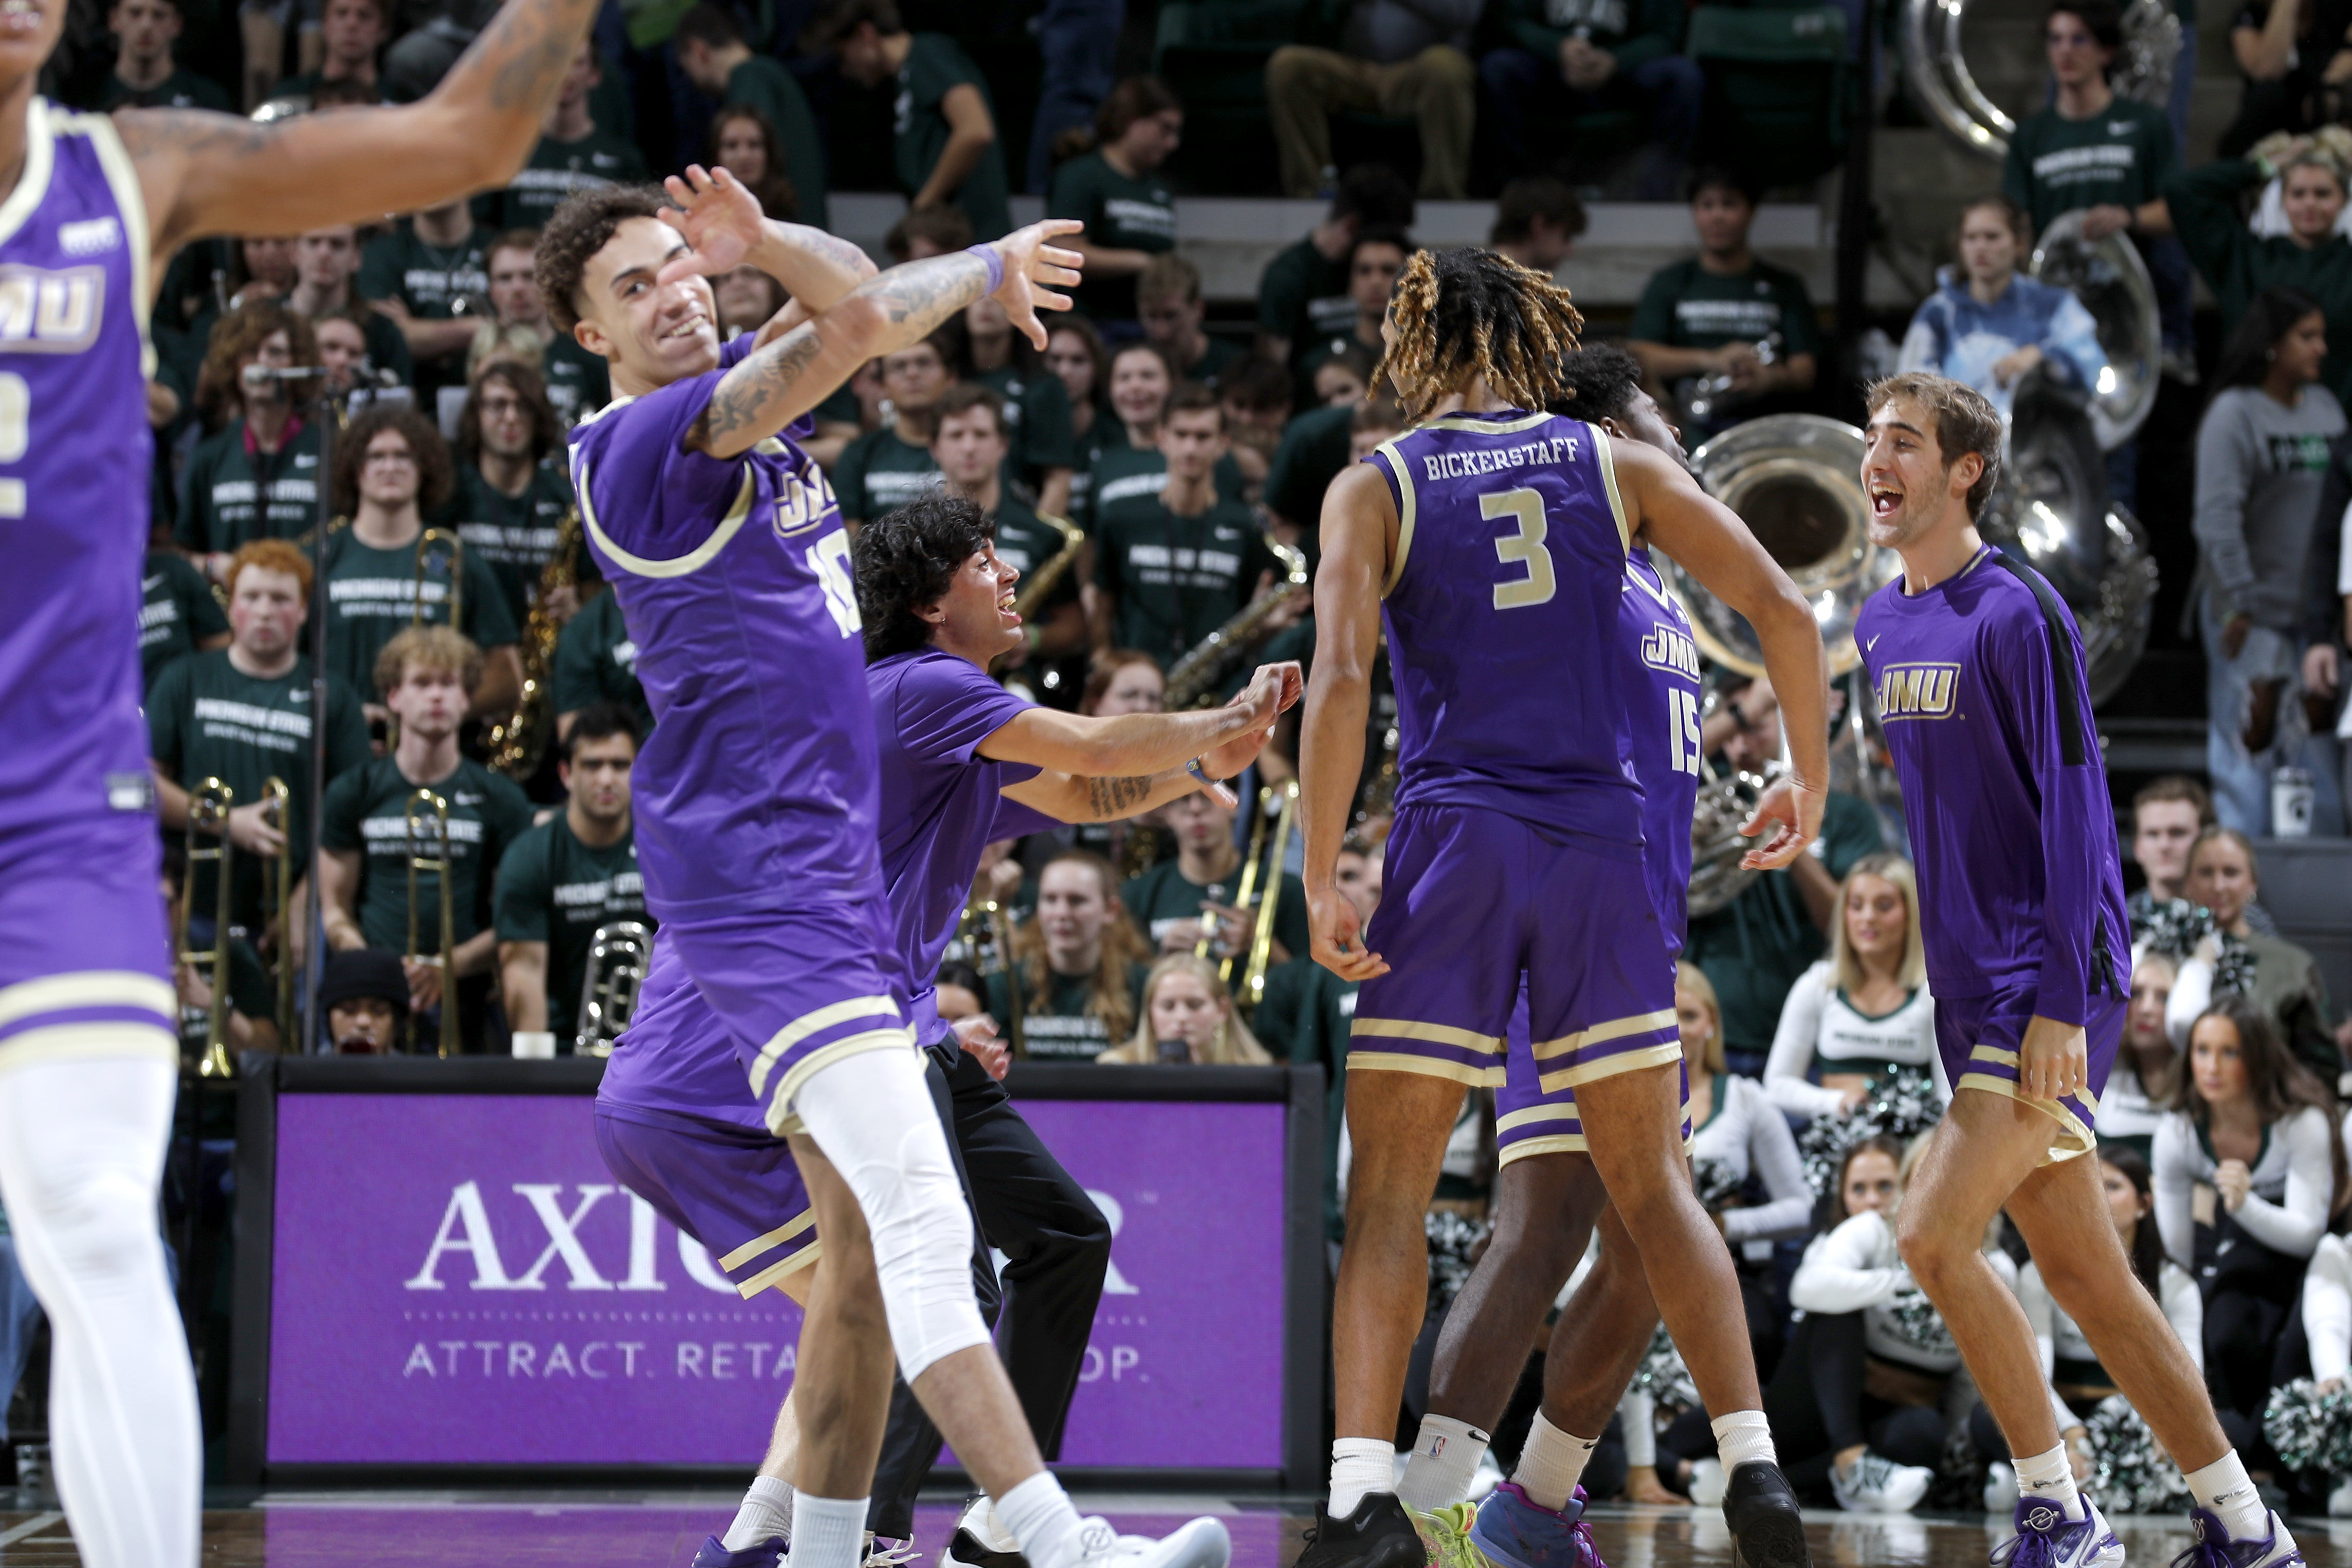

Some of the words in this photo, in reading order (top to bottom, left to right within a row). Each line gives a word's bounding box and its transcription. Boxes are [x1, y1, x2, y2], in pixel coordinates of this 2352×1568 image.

[1423, 436, 1579, 482] BICKERSTAFF
[1478, 486, 1557, 611] 3
[1644, 625, 1700, 681] JMU
[1877, 668, 1954, 717] JMU
[1668, 686, 1701, 777] 15
[403, 1340, 654, 1380] ATTRACT.
